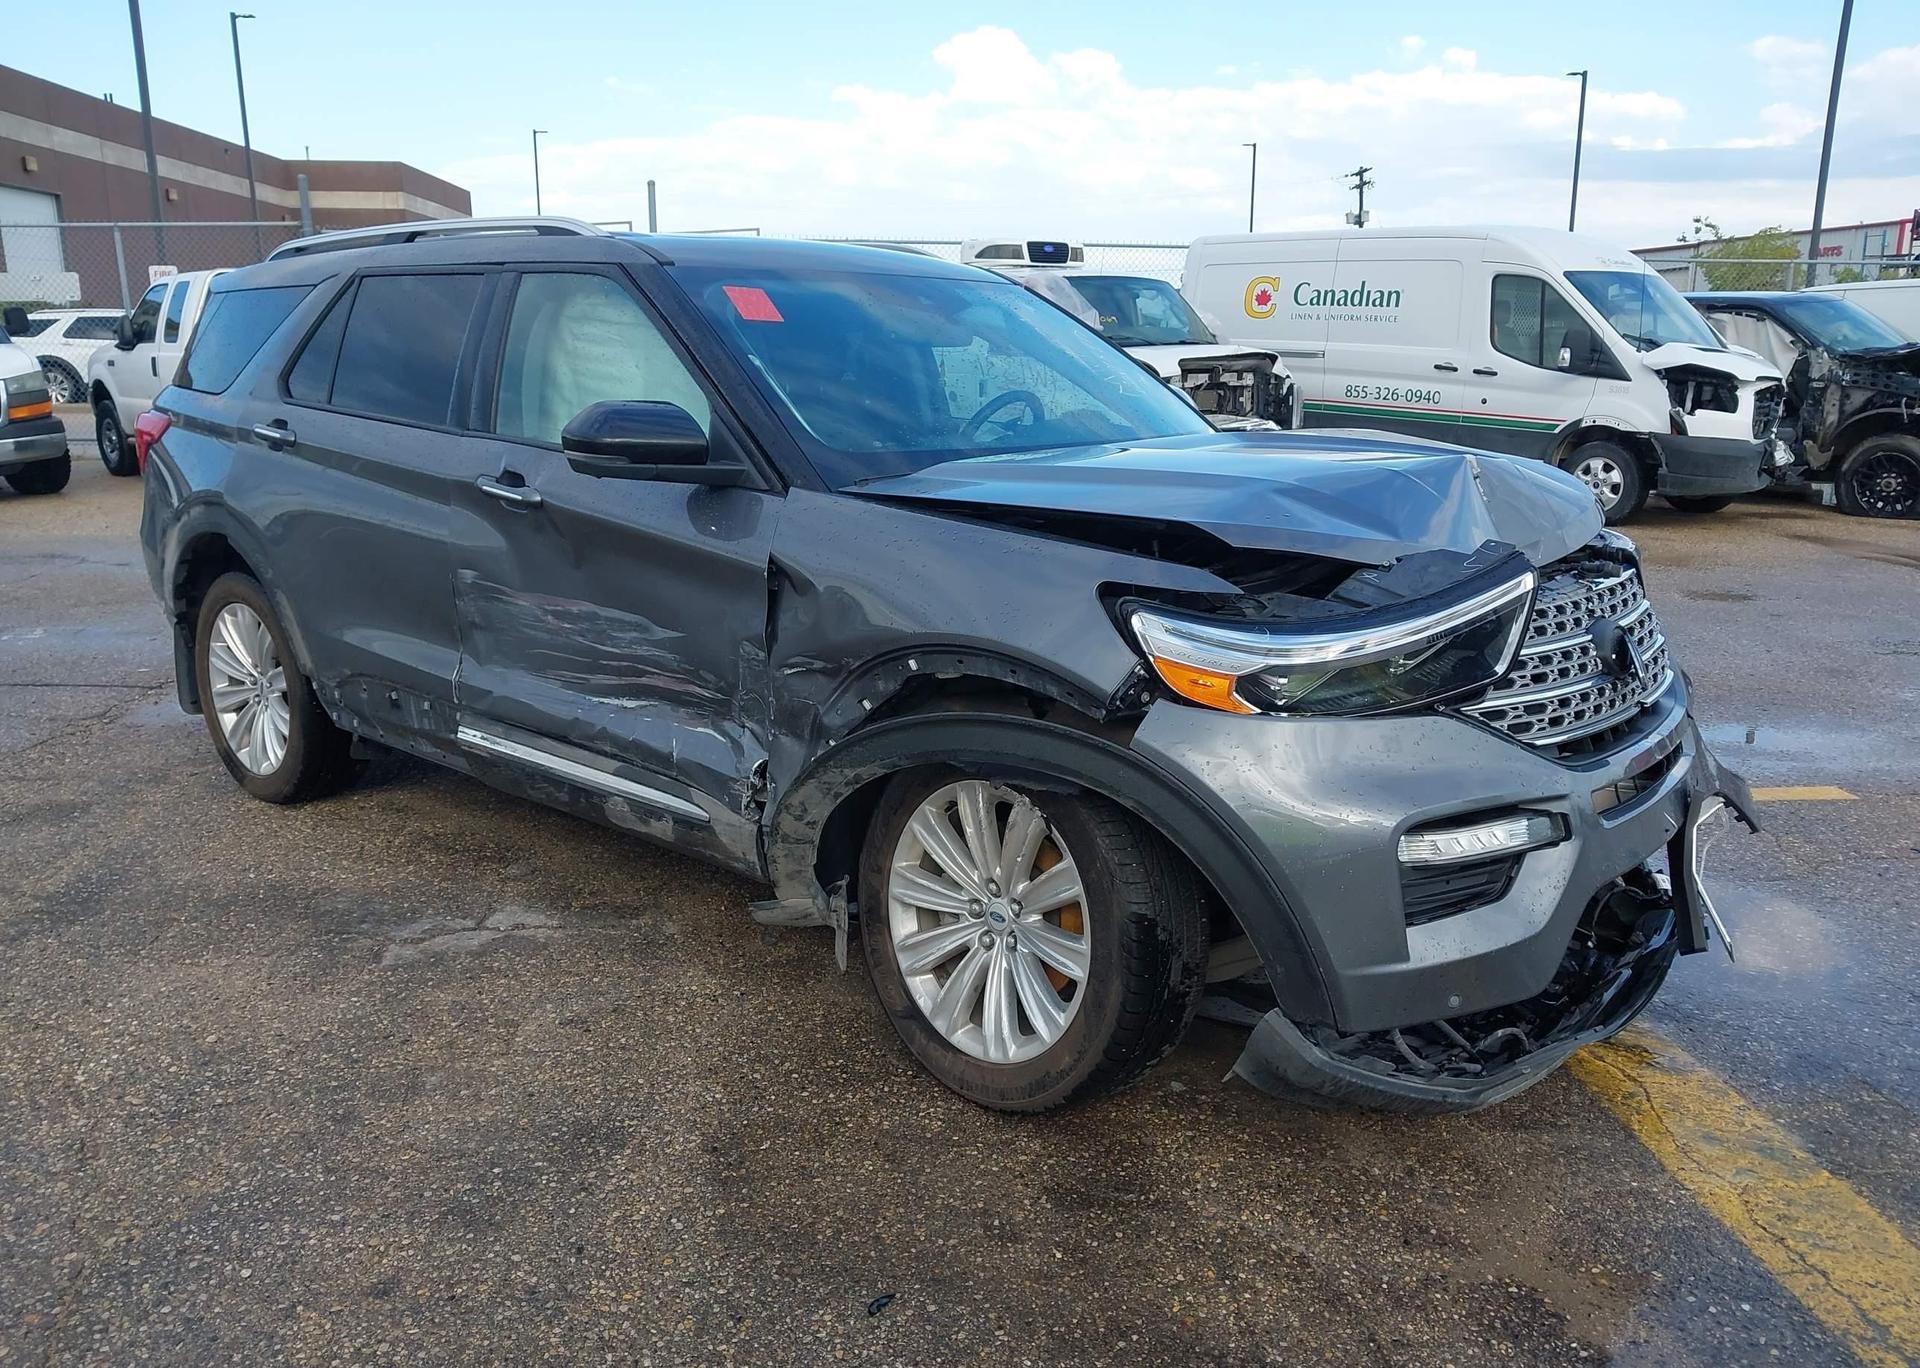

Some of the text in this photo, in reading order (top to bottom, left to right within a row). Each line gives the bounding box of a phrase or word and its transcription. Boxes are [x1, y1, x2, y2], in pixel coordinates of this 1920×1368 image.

[1817, 245, 1843, 257] ARTS
[1245, 276, 1280, 319] C
[1293, 280, 1401, 308] Canadian
[1290, 312, 1313, 321] LINEN
[1324, 313, 1362, 322] UNIFORM
[1365, 314, 1399, 323] SERVICE
[1344, 384, 1442, 405] 855-326-0940
